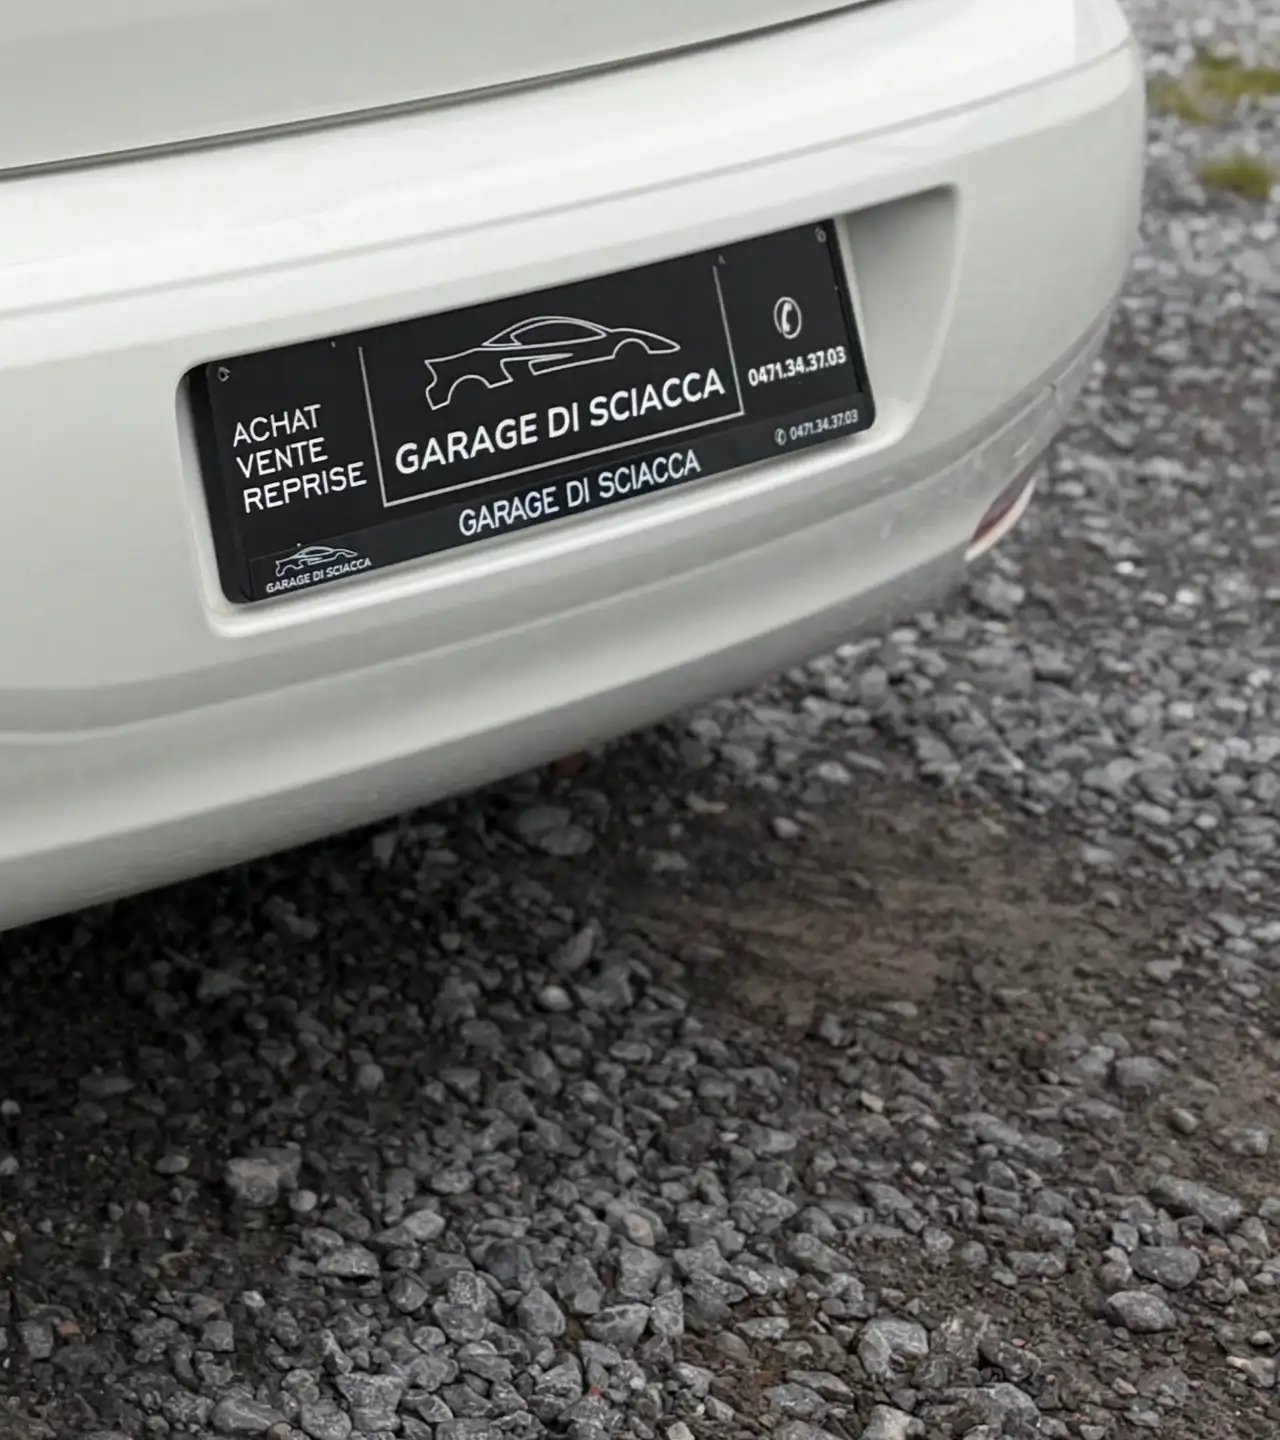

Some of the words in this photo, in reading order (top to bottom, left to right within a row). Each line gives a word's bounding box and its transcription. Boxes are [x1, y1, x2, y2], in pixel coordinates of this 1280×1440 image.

[748, 346, 847, 387] 0471.34.37.03
[233, 404, 321, 447] ACHAT
[395, 412, 538, 475] GARAGE
[548, 402, 580, 438] DI
[589, 368, 726, 427] SCIACCA
[789, 409, 858, 440] 0471.34.37.03
[236, 437, 328, 479] VENTE
[243, 461, 367, 513] REPRISE
[459, 486, 560, 537] GARAGE
[566, 477, 590, 508] DI
[598, 448, 701, 498] SCIACCA
[266, 572, 311, 594] GARAGE
[313, 570, 325, 583] DI
[326, 557, 372, 578] SCIACCA
